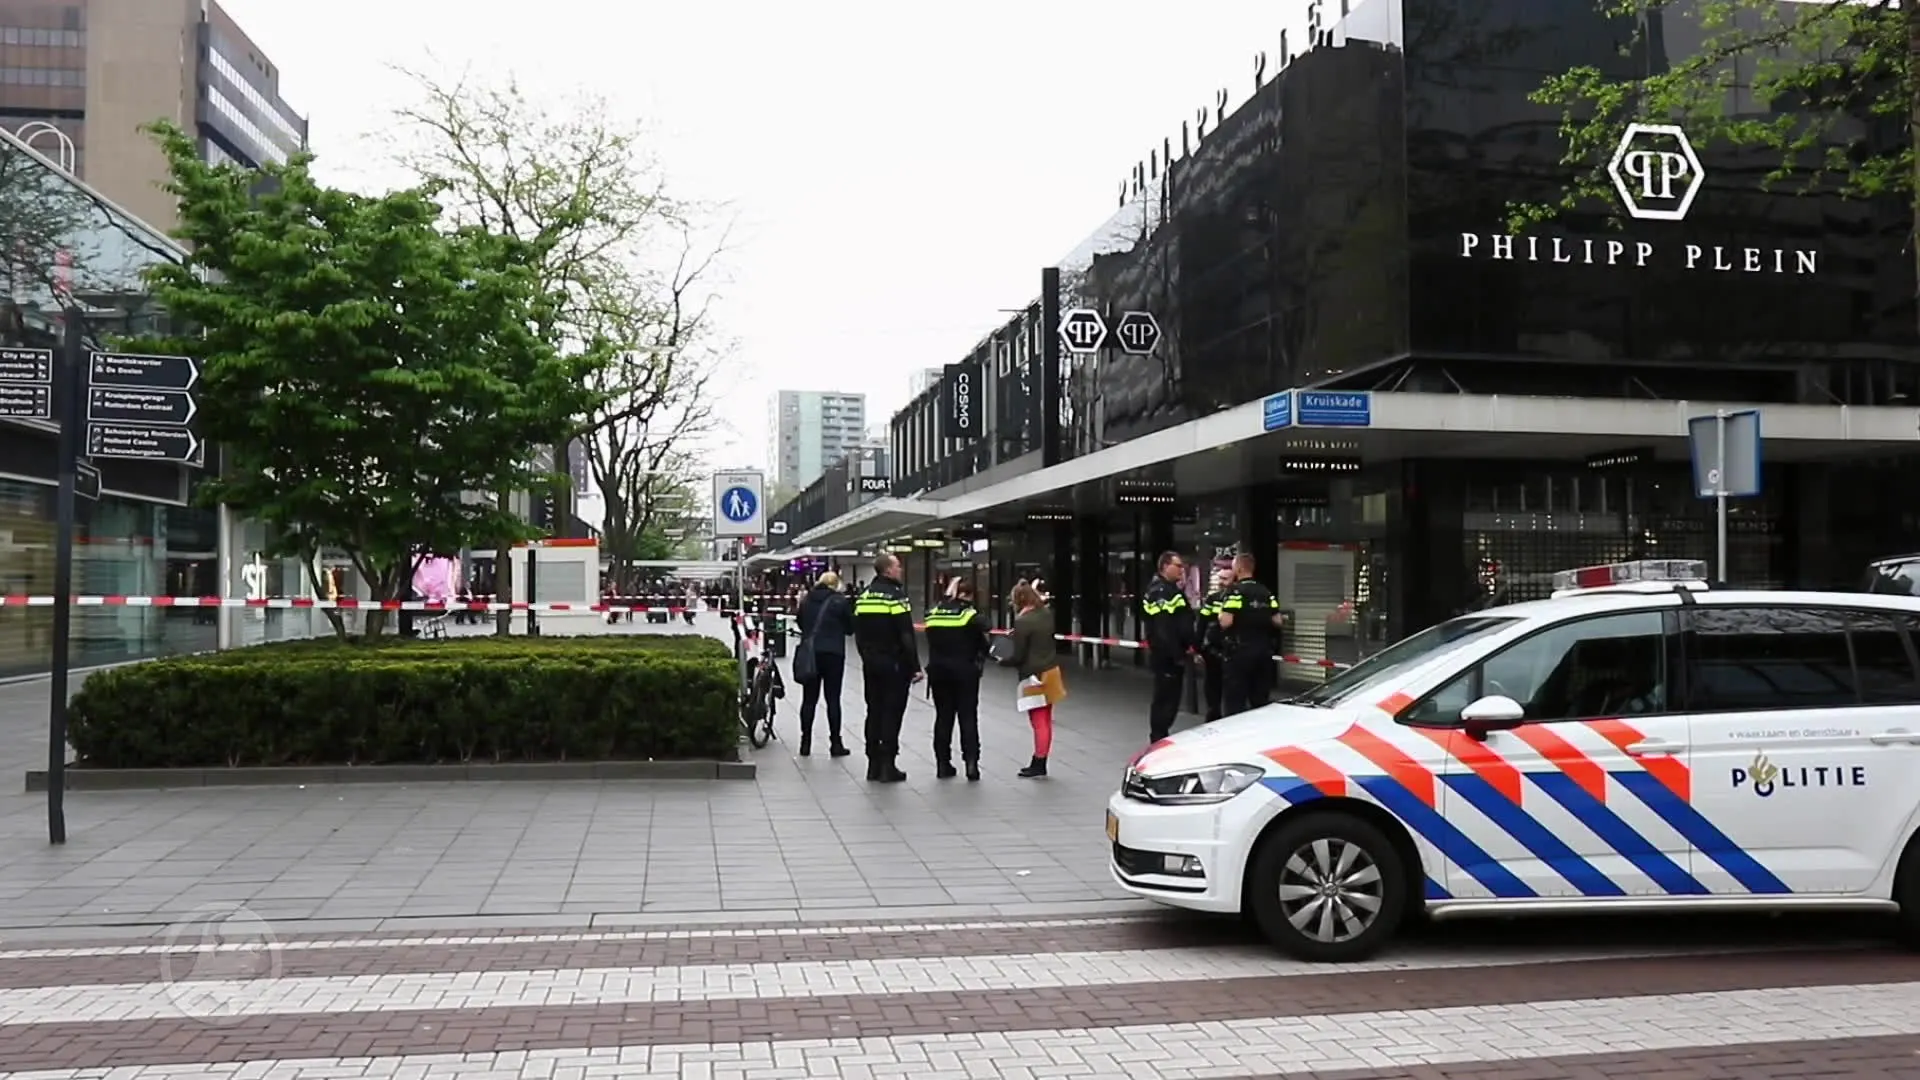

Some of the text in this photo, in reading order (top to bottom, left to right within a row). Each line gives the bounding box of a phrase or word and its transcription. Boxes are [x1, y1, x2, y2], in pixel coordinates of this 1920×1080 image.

[1460, 232, 1819, 274] PHILIPP PLEIN
[958, 372, 969, 429] COSMO
[1304, 395, 1363, 408] Kruiskade
[1285, 461, 1360, 471] PHILIPP PLEIN
[862, 479, 886, 490] POUR
[1731, 766, 1866, 798] POLITIE
